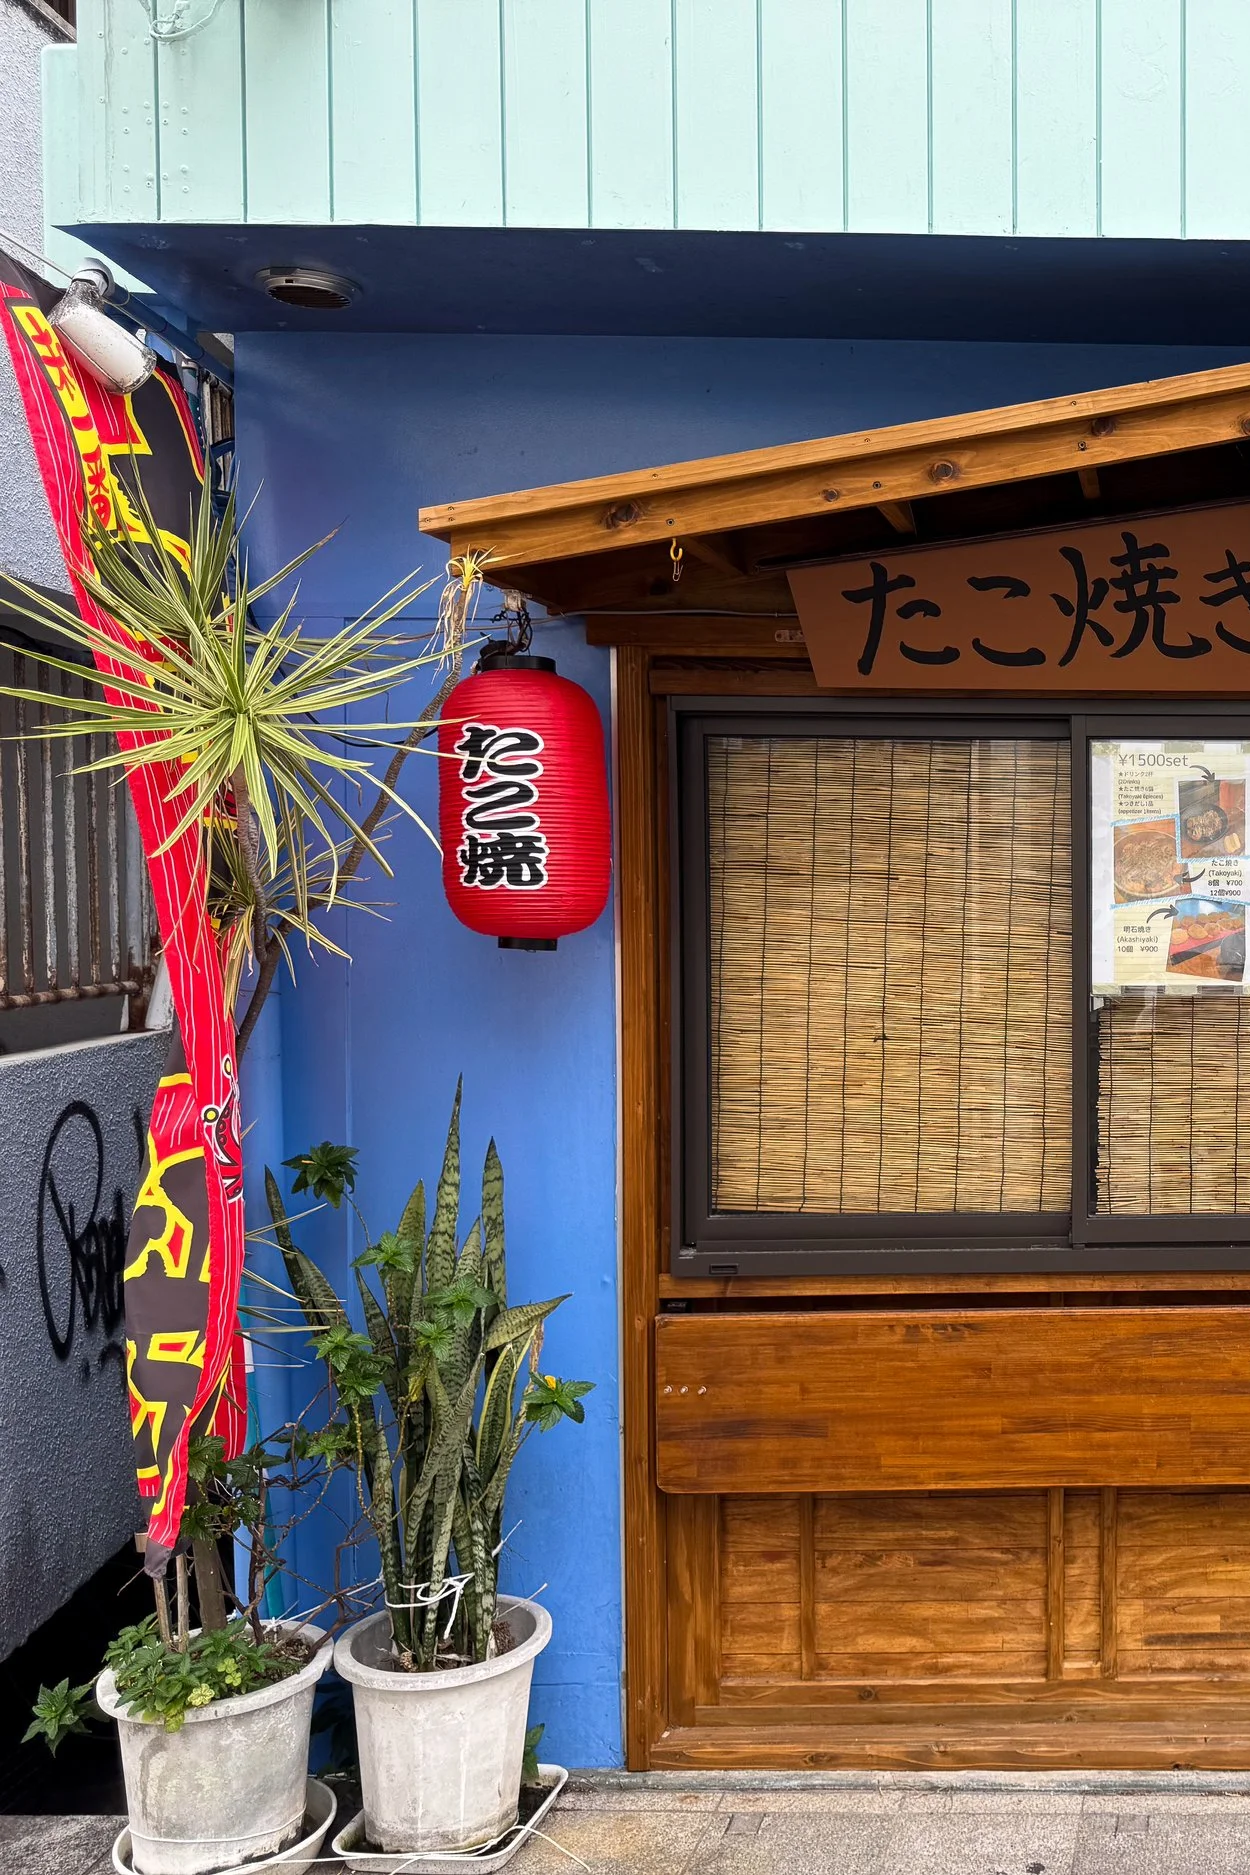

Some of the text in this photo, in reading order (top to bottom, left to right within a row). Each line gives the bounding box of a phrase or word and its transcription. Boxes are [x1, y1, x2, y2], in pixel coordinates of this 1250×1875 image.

[1118, 754, 1188, 767] ¥1500set
[455, 723, 549, 889] たこ焼
[1211, 859, 1239, 867] たこ焼き
[1123, 925, 1152, 933] 明石焼き
